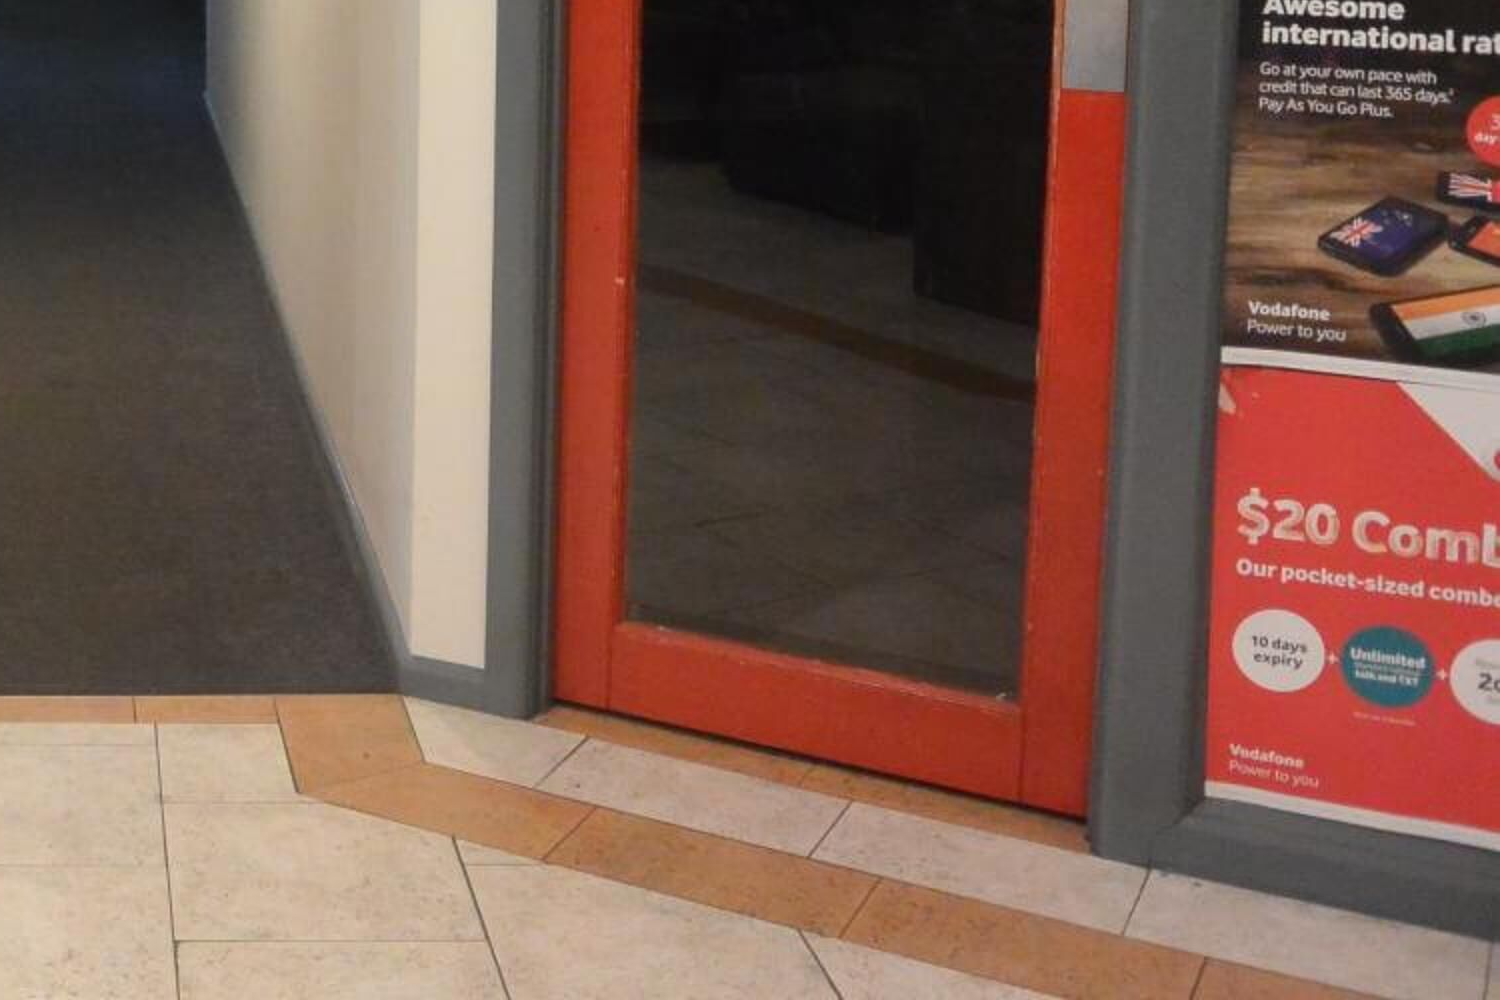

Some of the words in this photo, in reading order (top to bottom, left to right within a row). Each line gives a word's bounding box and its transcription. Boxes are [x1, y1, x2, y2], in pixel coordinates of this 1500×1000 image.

[1262, 21, 1456, 54] international
[1260, 63, 1281, 77] Go
[1284, 64, 1298, 77] at
[1300, 66, 1331, 82] your
[1334, 68, 1365, 81] own
[1367, 70, 1402, 86] pace
[1405, 69, 1437, 85] with
[1259, 80, 1298, 96] credit
[1301, 81, 1327, 97] that
[1329, 85, 1354, 98] can
[1356, 84, 1383, 99] last
[1385, 86, 1412, 101] 365
[1259, 97, 1283, 115] Pay
[1286, 98, 1305, 113] As
[1307, 100, 1334, 115] You
[1336, 101, 1357, 116] Go
[1360, 102, 1394, 118] Plus.
[1249, 299, 1331, 322] Vodafone
[1247, 318, 1295, 338] Power
[1297, 321, 1314, 338] to
[1316, 326, 1347, 343] you
[1237, 486, 1340, 546] $20
[1236, 557, 1276, 579] Our
[1280, 563, 1425, 600] pocket-sized
[1251, 634, 1269, 650] 10
[1271, 637, 1308, 656] days
[1253, 651, 1304, 672] expiry
[1350, 647, 1427, 669] Unlimited
[1229, 743, 1305, 769] Vodafone
[1228, 758, 1273, 778] Power
[1274, 766, 1290, 783] to
[1292, 770, 1320, 790] you
